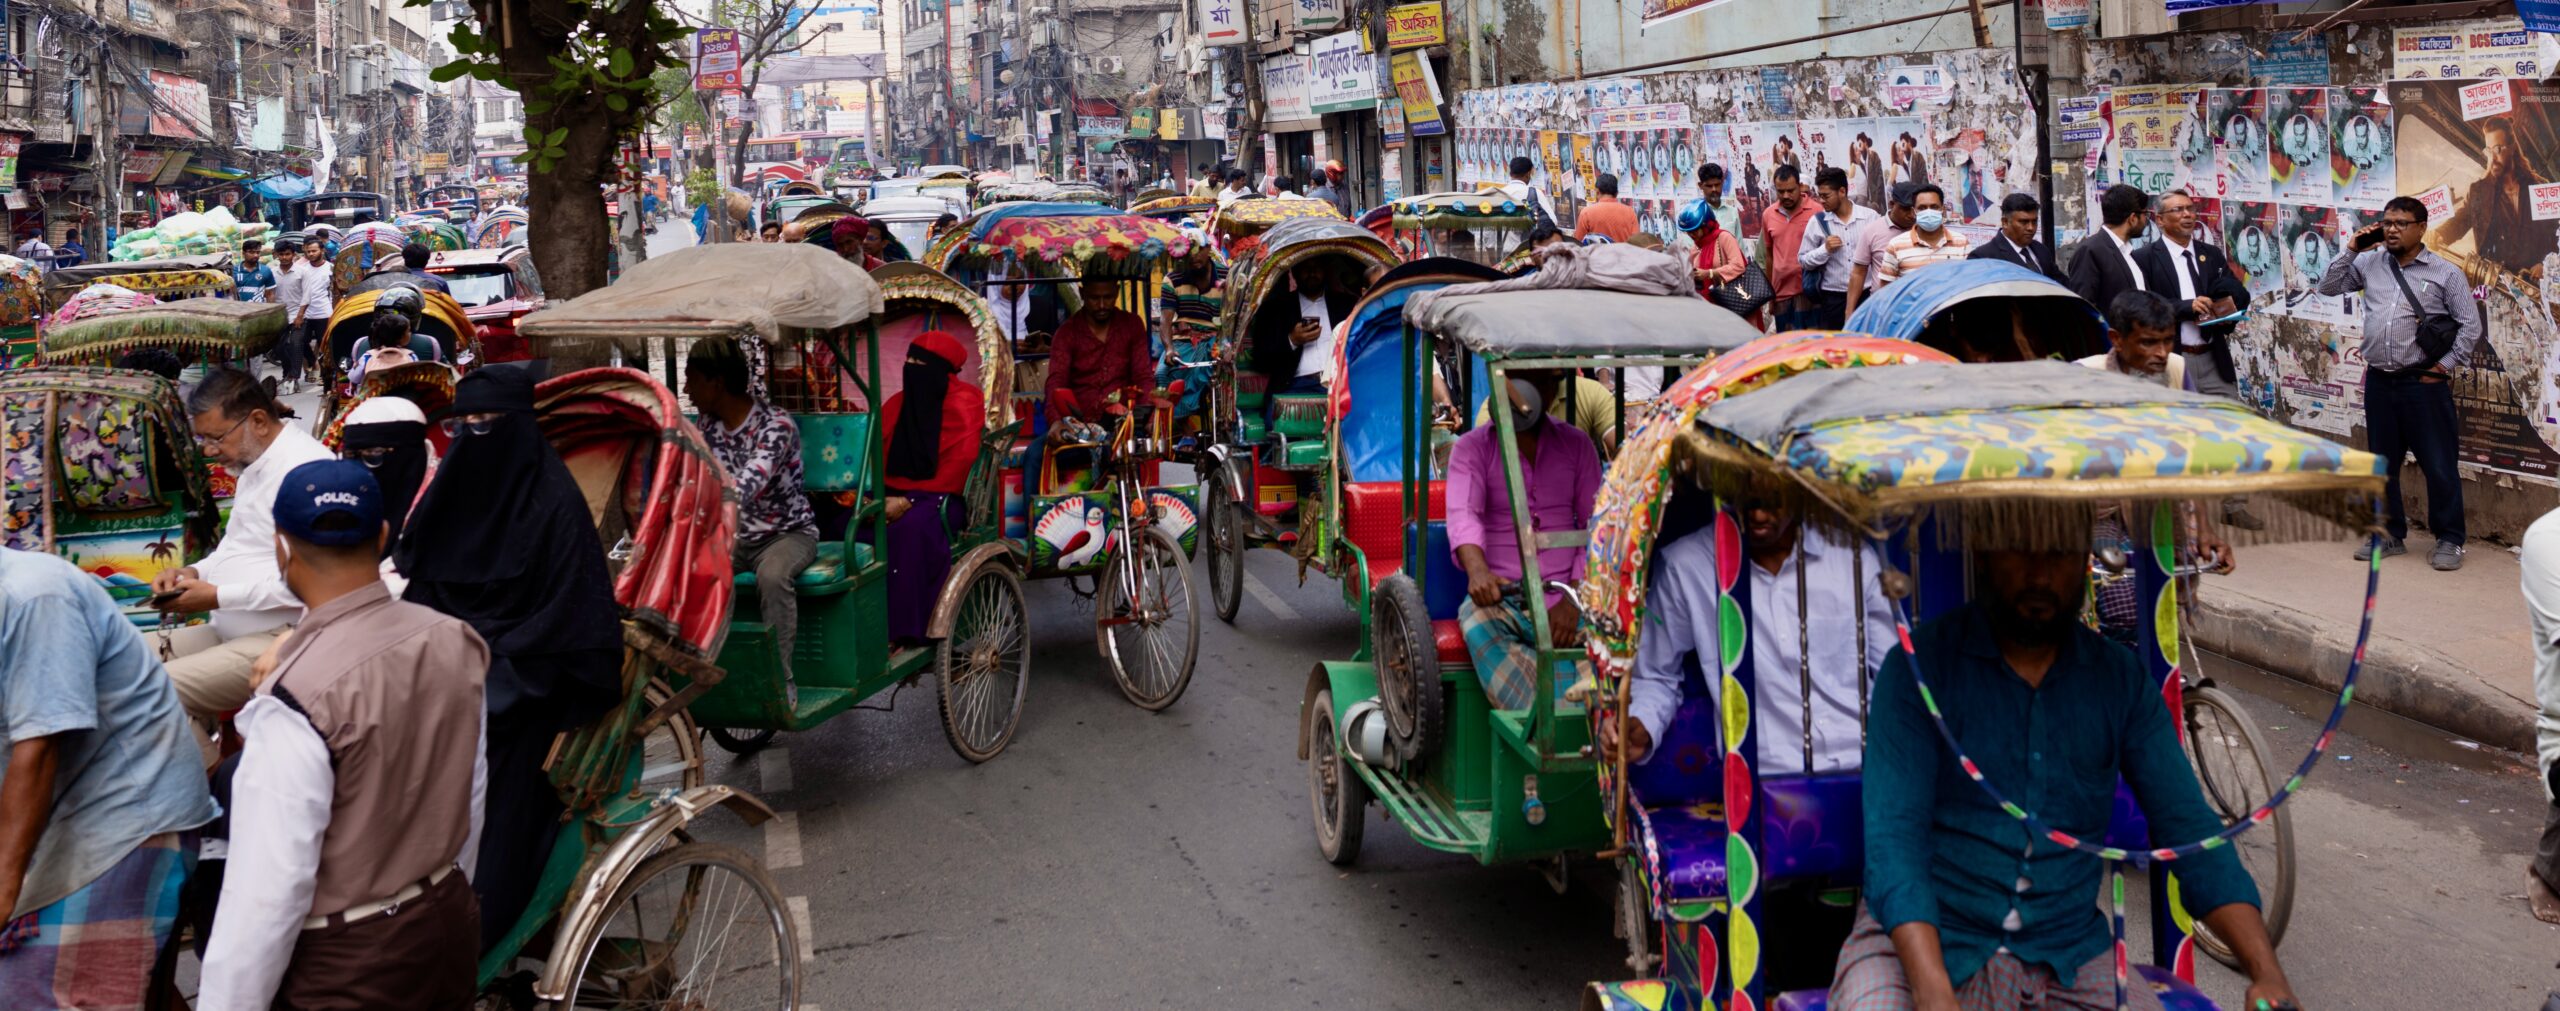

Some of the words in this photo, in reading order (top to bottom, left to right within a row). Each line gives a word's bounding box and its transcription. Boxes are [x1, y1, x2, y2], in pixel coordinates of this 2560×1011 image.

[1400, 12, 1437, 32] অফিস
[2398, 37, 2418, 51] BCS
[2470, 34, 2490, 48] BCS
[2441, 65, 2460, 78] প্রিলি
[2516, 61, 2536, 76] প্রিলি
[2464, 81, 2503, 99] আজাদে
[2466, 97, 2505, 111] চলিতেছে
[2542, 95, 2560, 103] SULTA
[2419, 189, 2444, 206] জাদে
[2453, 366, 2516, 404] RIN
[2462, 400, 2482, 409] UPON
[2490, 404, 2509, 414] TIME
[2526, 461, 2546, 470] LOTTO
[314, 492, 359, 507] POLICE
